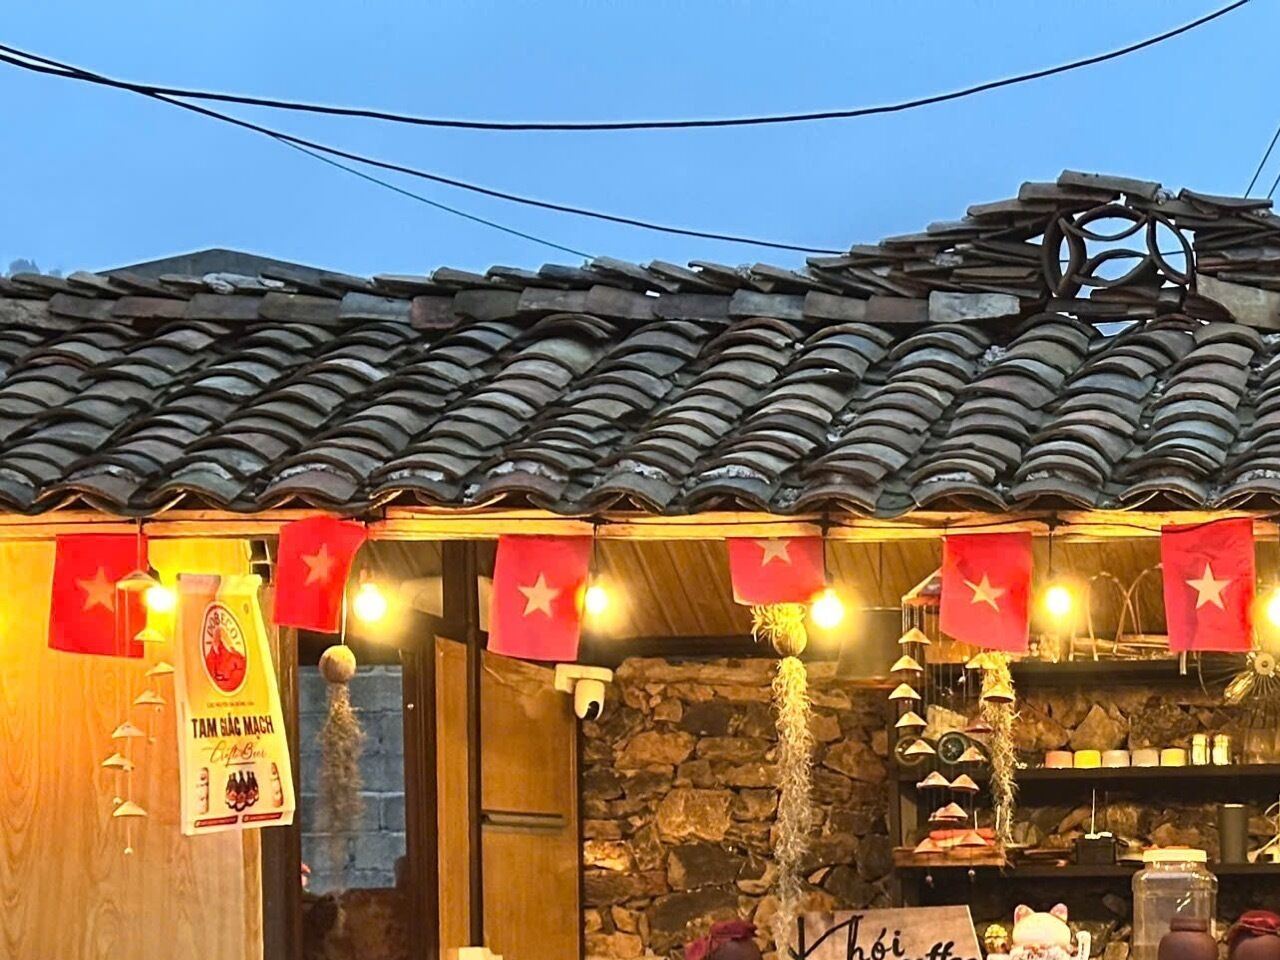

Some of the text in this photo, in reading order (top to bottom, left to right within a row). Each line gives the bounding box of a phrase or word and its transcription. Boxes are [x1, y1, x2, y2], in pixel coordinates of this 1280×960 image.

[191, 712, 275, 740] TAM GIÁC MẠCH
